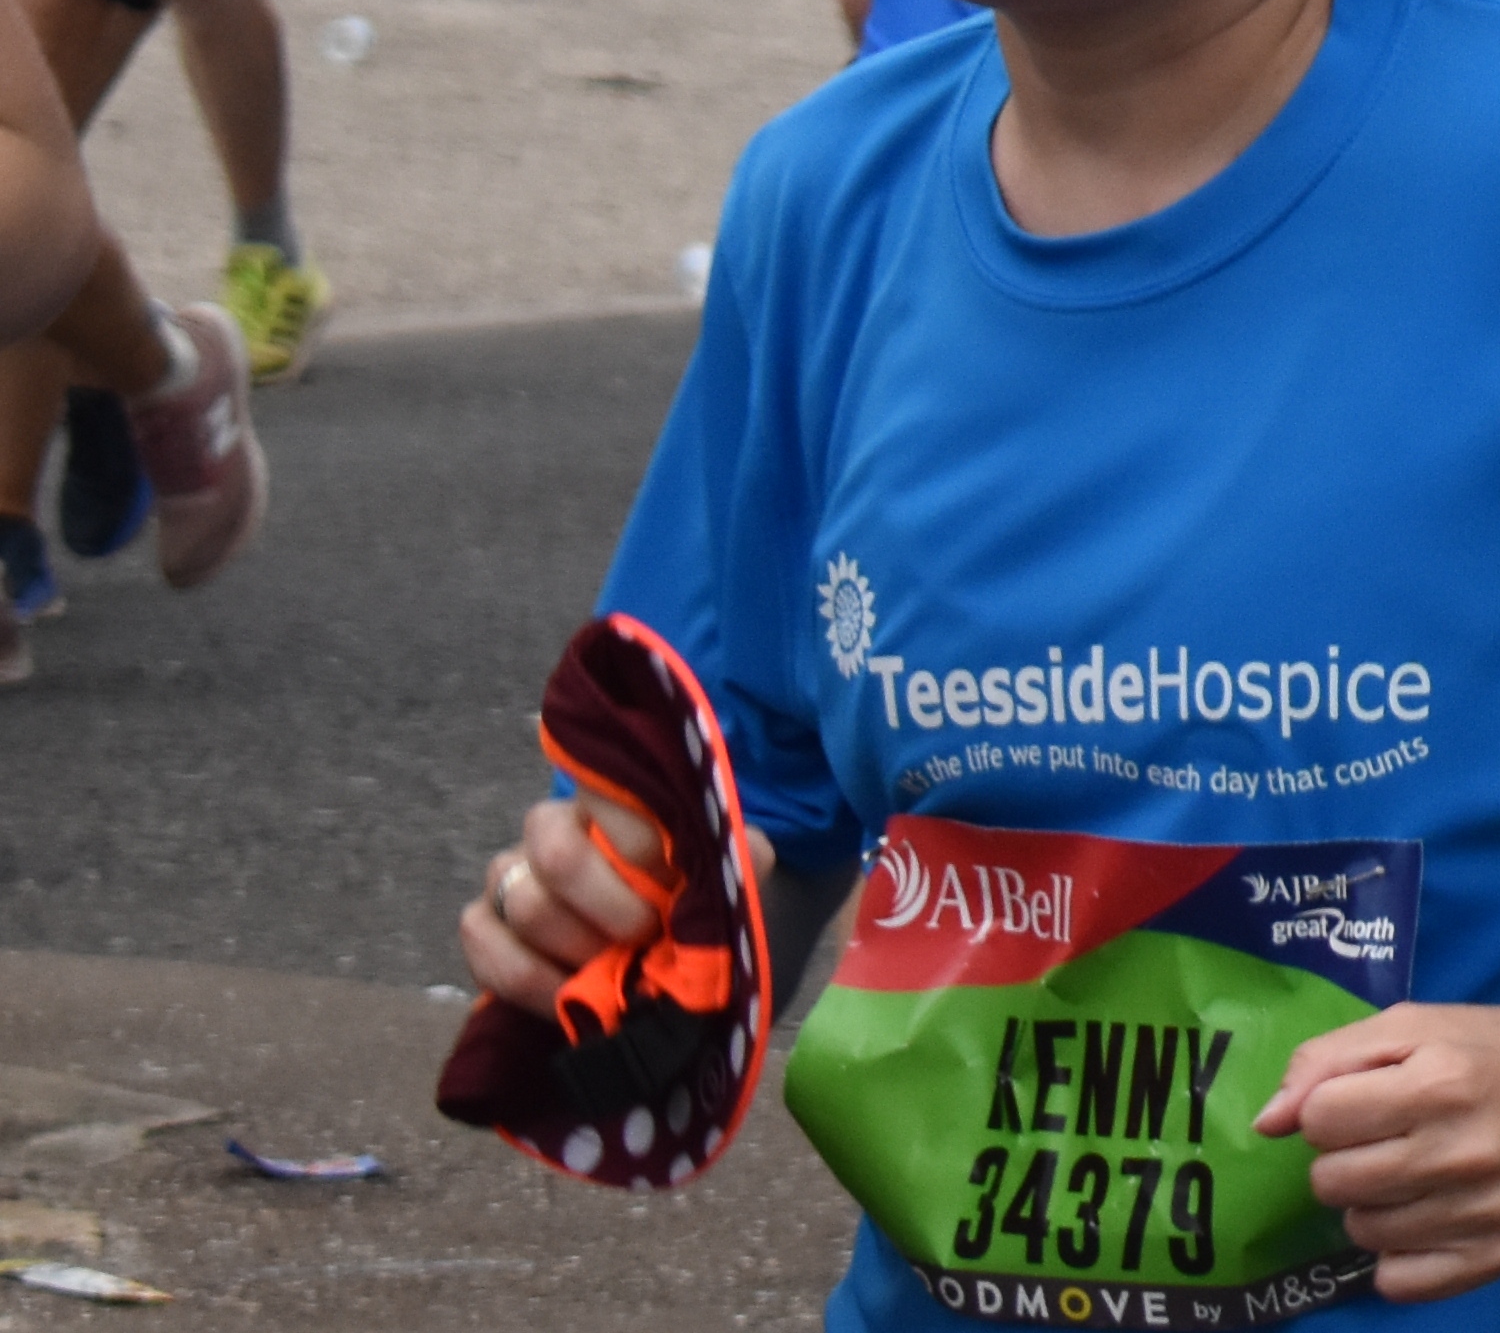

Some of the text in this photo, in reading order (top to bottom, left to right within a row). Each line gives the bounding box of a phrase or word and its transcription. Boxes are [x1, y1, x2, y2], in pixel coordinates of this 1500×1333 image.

[926, 754, 963, 783] the
[965, 741, 1003, 773] life
[1008, 744, 1042, 766] we
[1050, 744, 1086, 772] put
[1092, 745, 1140, 780] into
[1147, 763, 1200, 792] each
[1210, 764, 1259, 800] day
[1266, 763, 1328, 795] that
[1334, 736, 1430, 786] counts
[927, 865, 1073, 945] AJBell
[1271, 914, 1396, 945] great north
[1361, 943, 1395, 961] run
[986, 1016, 1234, 1144] KENNY
[953, 1145, 1215, 1276] 34379
[914, 1264, 1339, 1324] ODMOVE by M&S
